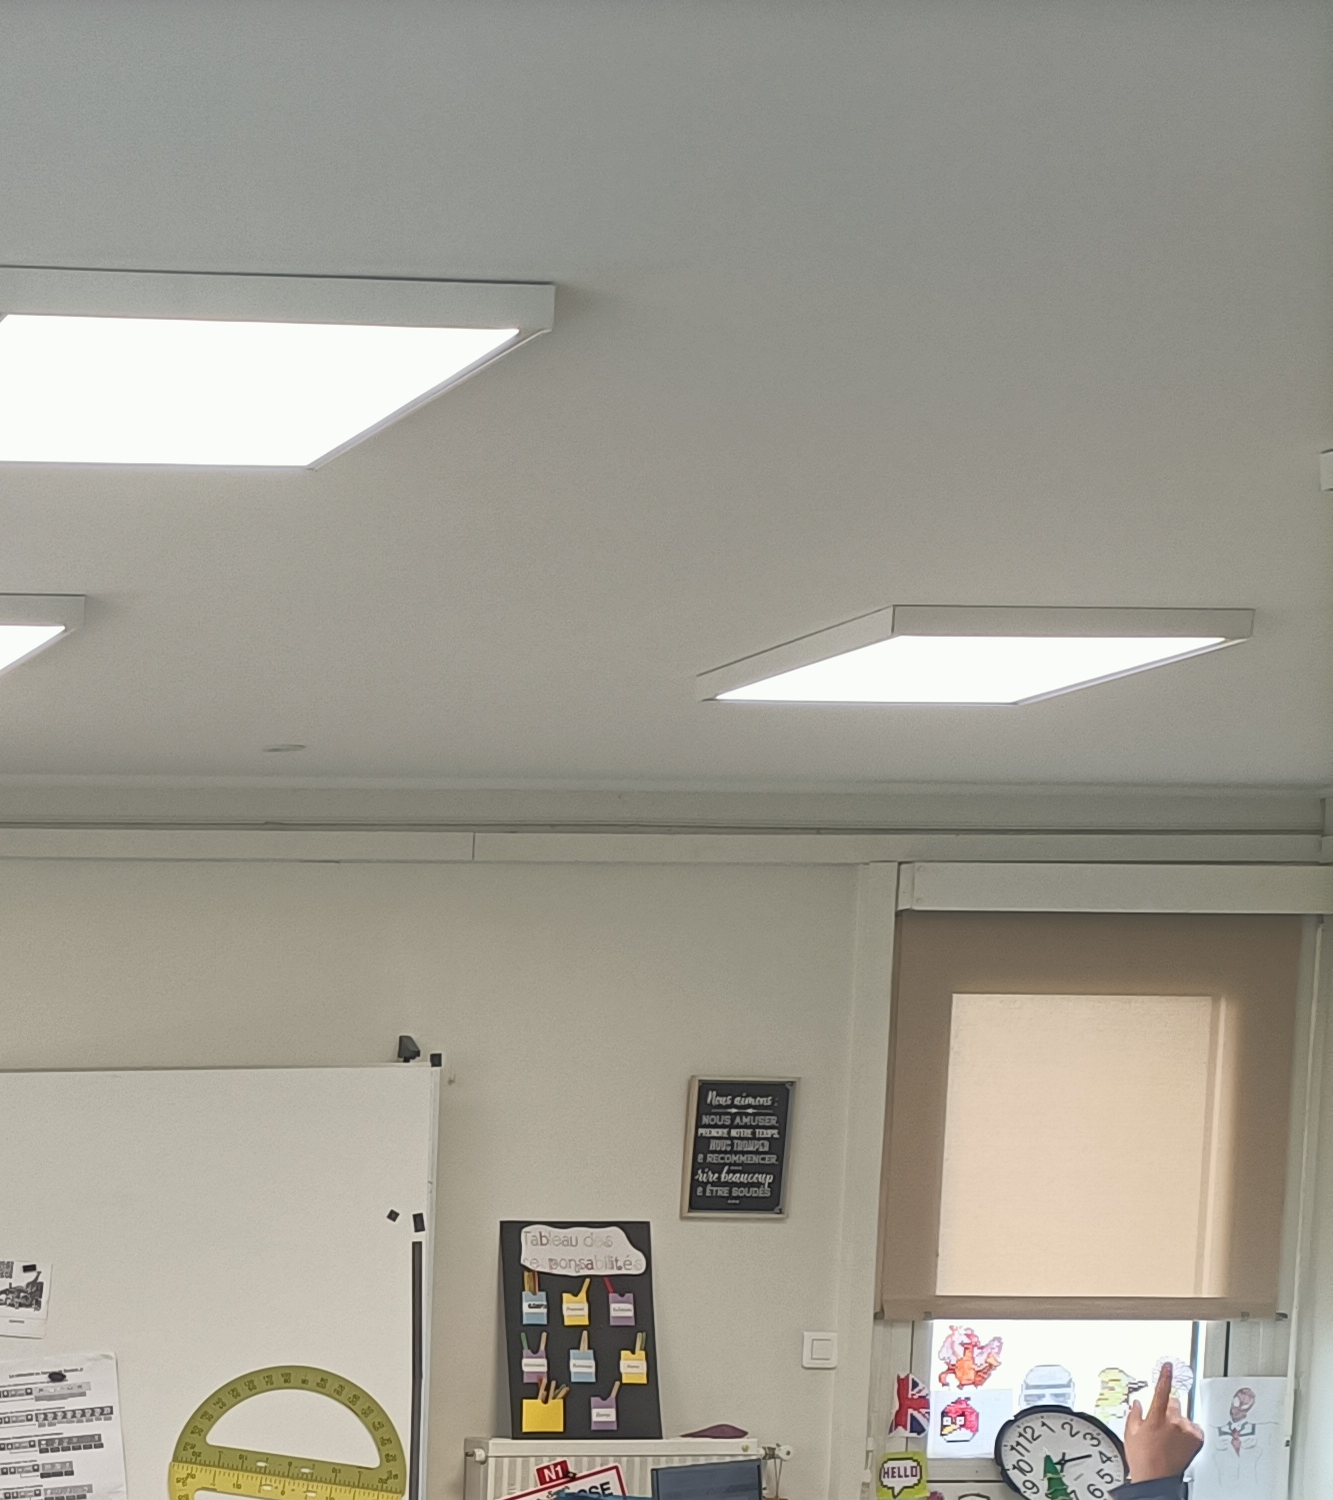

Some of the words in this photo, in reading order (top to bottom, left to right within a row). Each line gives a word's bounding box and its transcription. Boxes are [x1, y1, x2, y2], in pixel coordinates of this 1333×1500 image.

[707, 1090, 732, 1106] Nous
[701, 1115, 731, 1125] NOUS
[695, 1168, 718, 1182] rire
[721, 1165, 773, 1189] beaucoup
[706, 1184, 729, 1197] ÊTRE
[732, 1185, 771, 1197] SOUDÉS
[524, 1230, 579, 1249] Tableau
[1018, 1425, 1042, 1444] 12
[1041, 1421, 1056, 1433] 1
[1061, 1421, 1081, 1438] 2
[1082, 1432, 1101, 1448] 3
[1010, 1440, 1031, 1458] 11
[1098, 1450, 1114, 1464] 4
[543, 1465, 564, 1482] N1
[882, 1466, 918, 1479] HELLO
[1012, 1459, 1034, 1476] 10
[1096, 1468, 1115, 1485] 5
[1022, 1480, 1040, 1495] 9
[1087, 1483, 1105, 1499] 6
